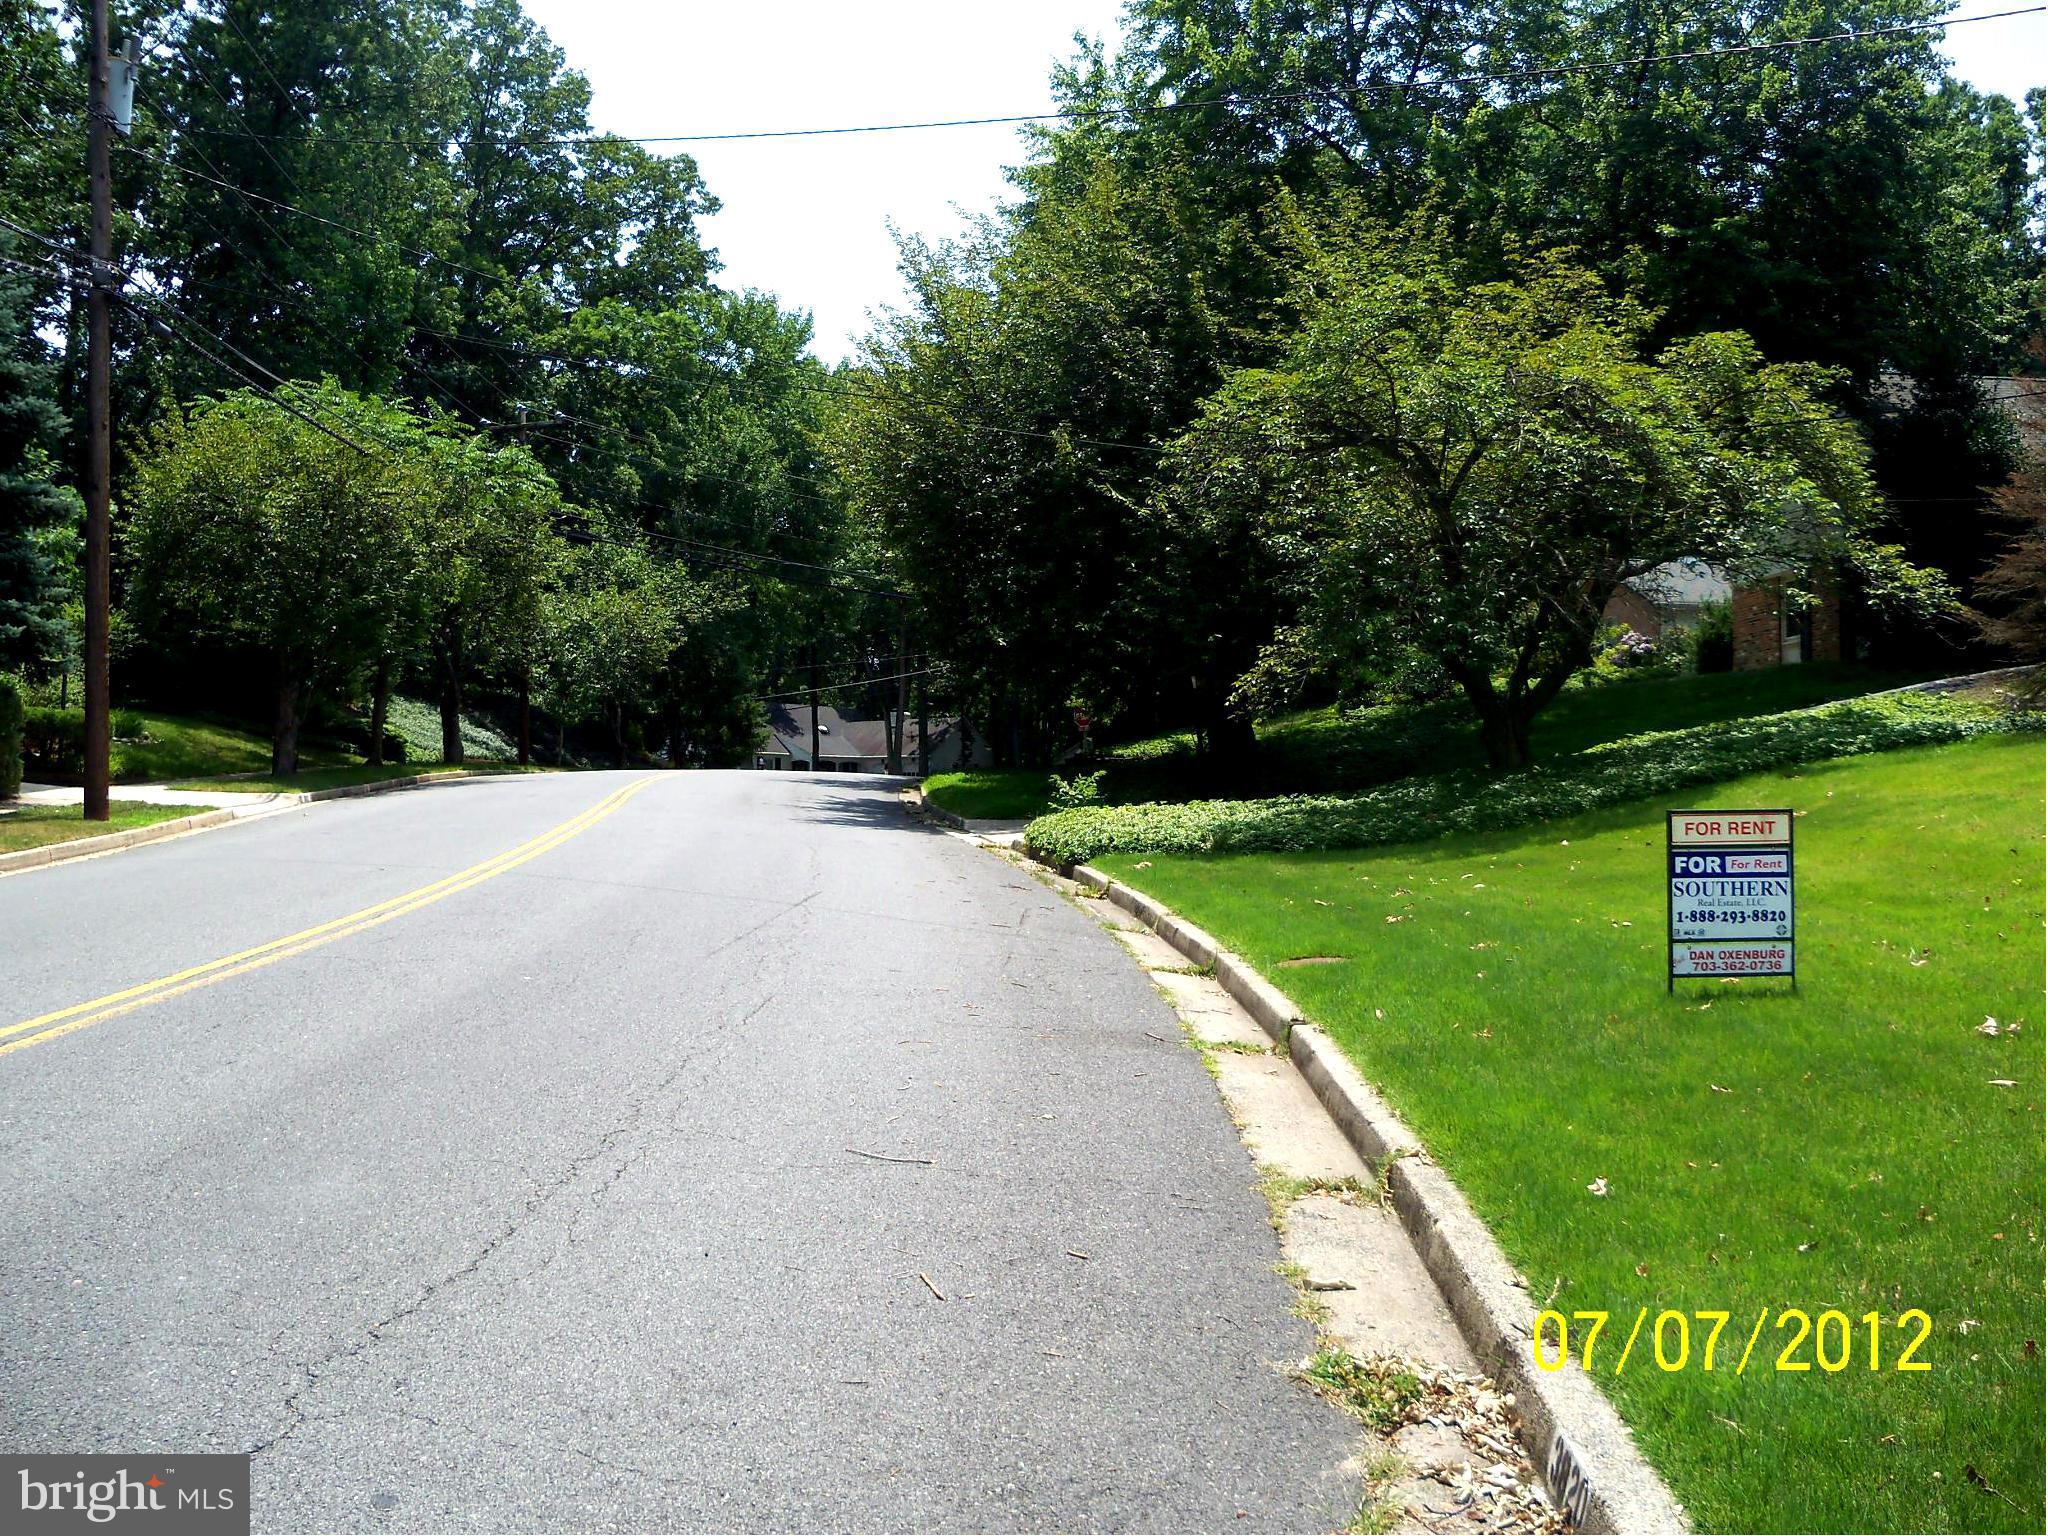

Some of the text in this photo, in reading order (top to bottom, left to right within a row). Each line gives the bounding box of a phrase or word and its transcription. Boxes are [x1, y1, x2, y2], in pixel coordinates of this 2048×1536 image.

[1684, 821, 1776, 836] FOR RENT
[1674, 856, 1783, 874] FOR For Rent
[1673, 880, 1788, 898] SOUTHERN
[1697, 898, 1715, 907] Real
[1689, 949, 1785, 961] DAN OXENBURG
[1692, 960, 1782, 971] 703-362-0736
